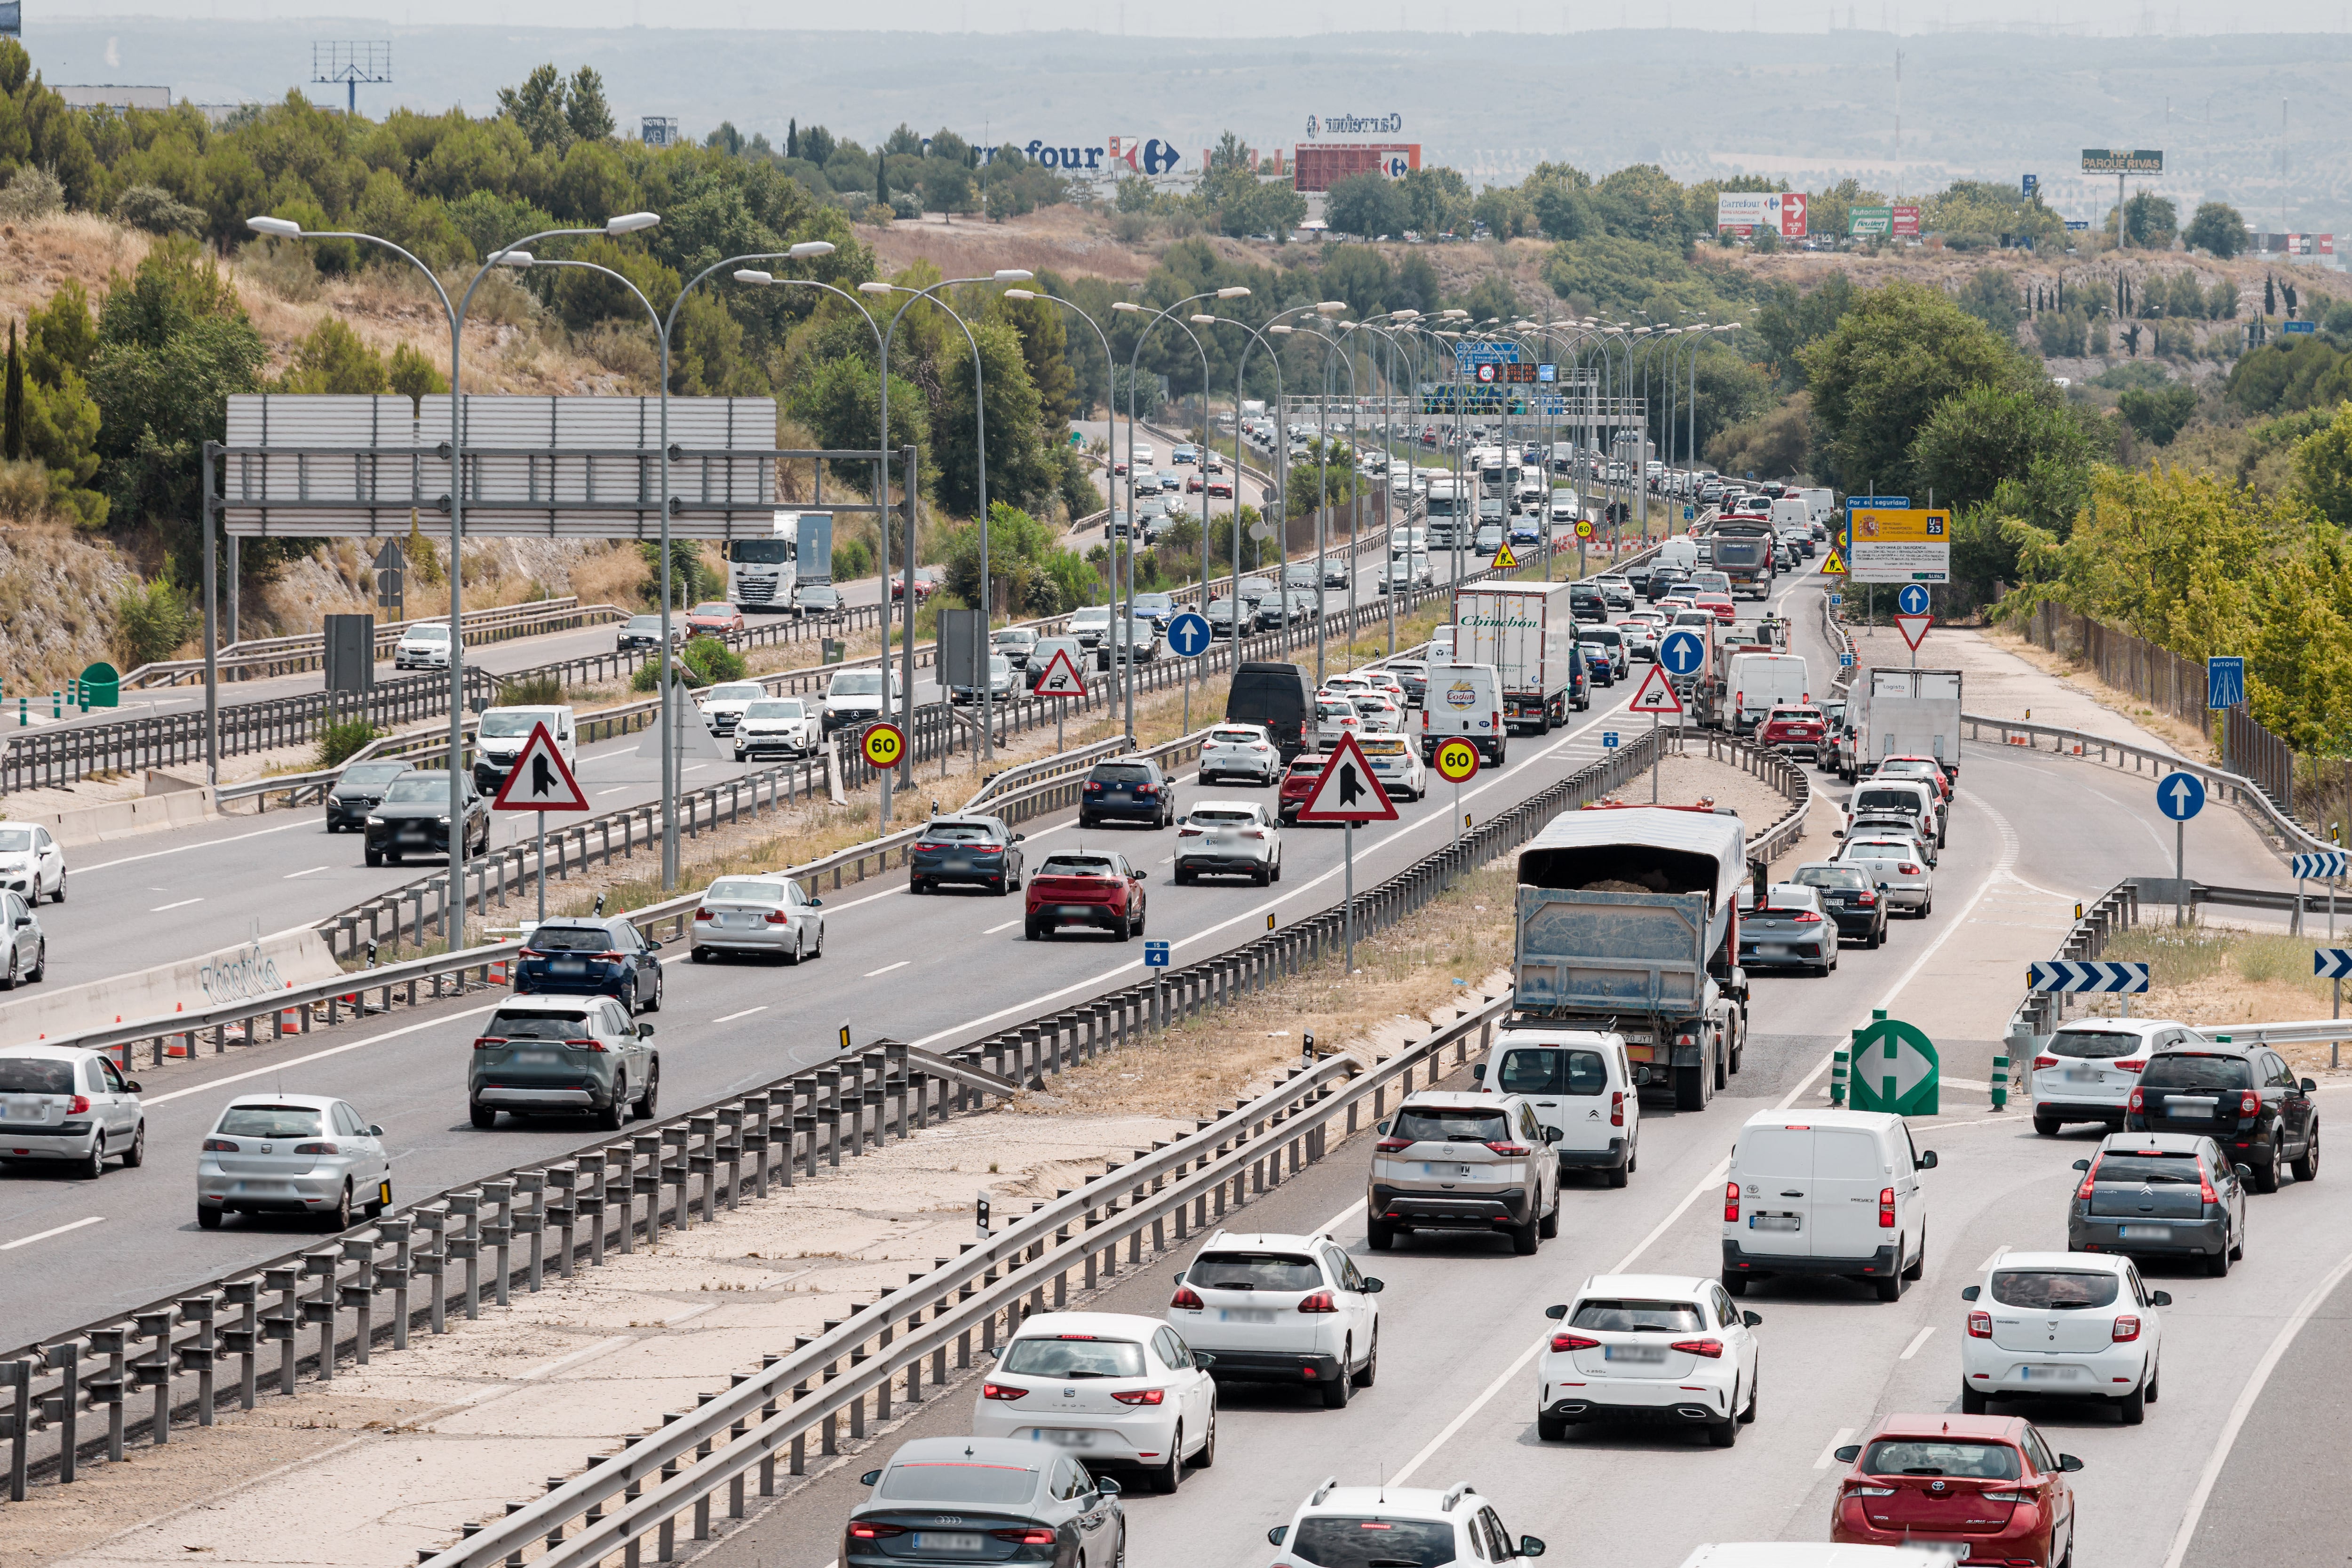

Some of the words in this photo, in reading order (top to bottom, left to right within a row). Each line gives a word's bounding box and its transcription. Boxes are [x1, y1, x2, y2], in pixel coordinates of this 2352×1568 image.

[2083, 158, 2126, 168] PARQUE
[2127, 159, 2160, 168] RIVAS
[1721, 199, 1760, 208] Carrefour
[1461, 615, 1537, 628] Chinchón
[872, 738, 895, 753] 60
[1445, 752, 1469, 767] 60
[1153, 953, 1161, 963] 4
